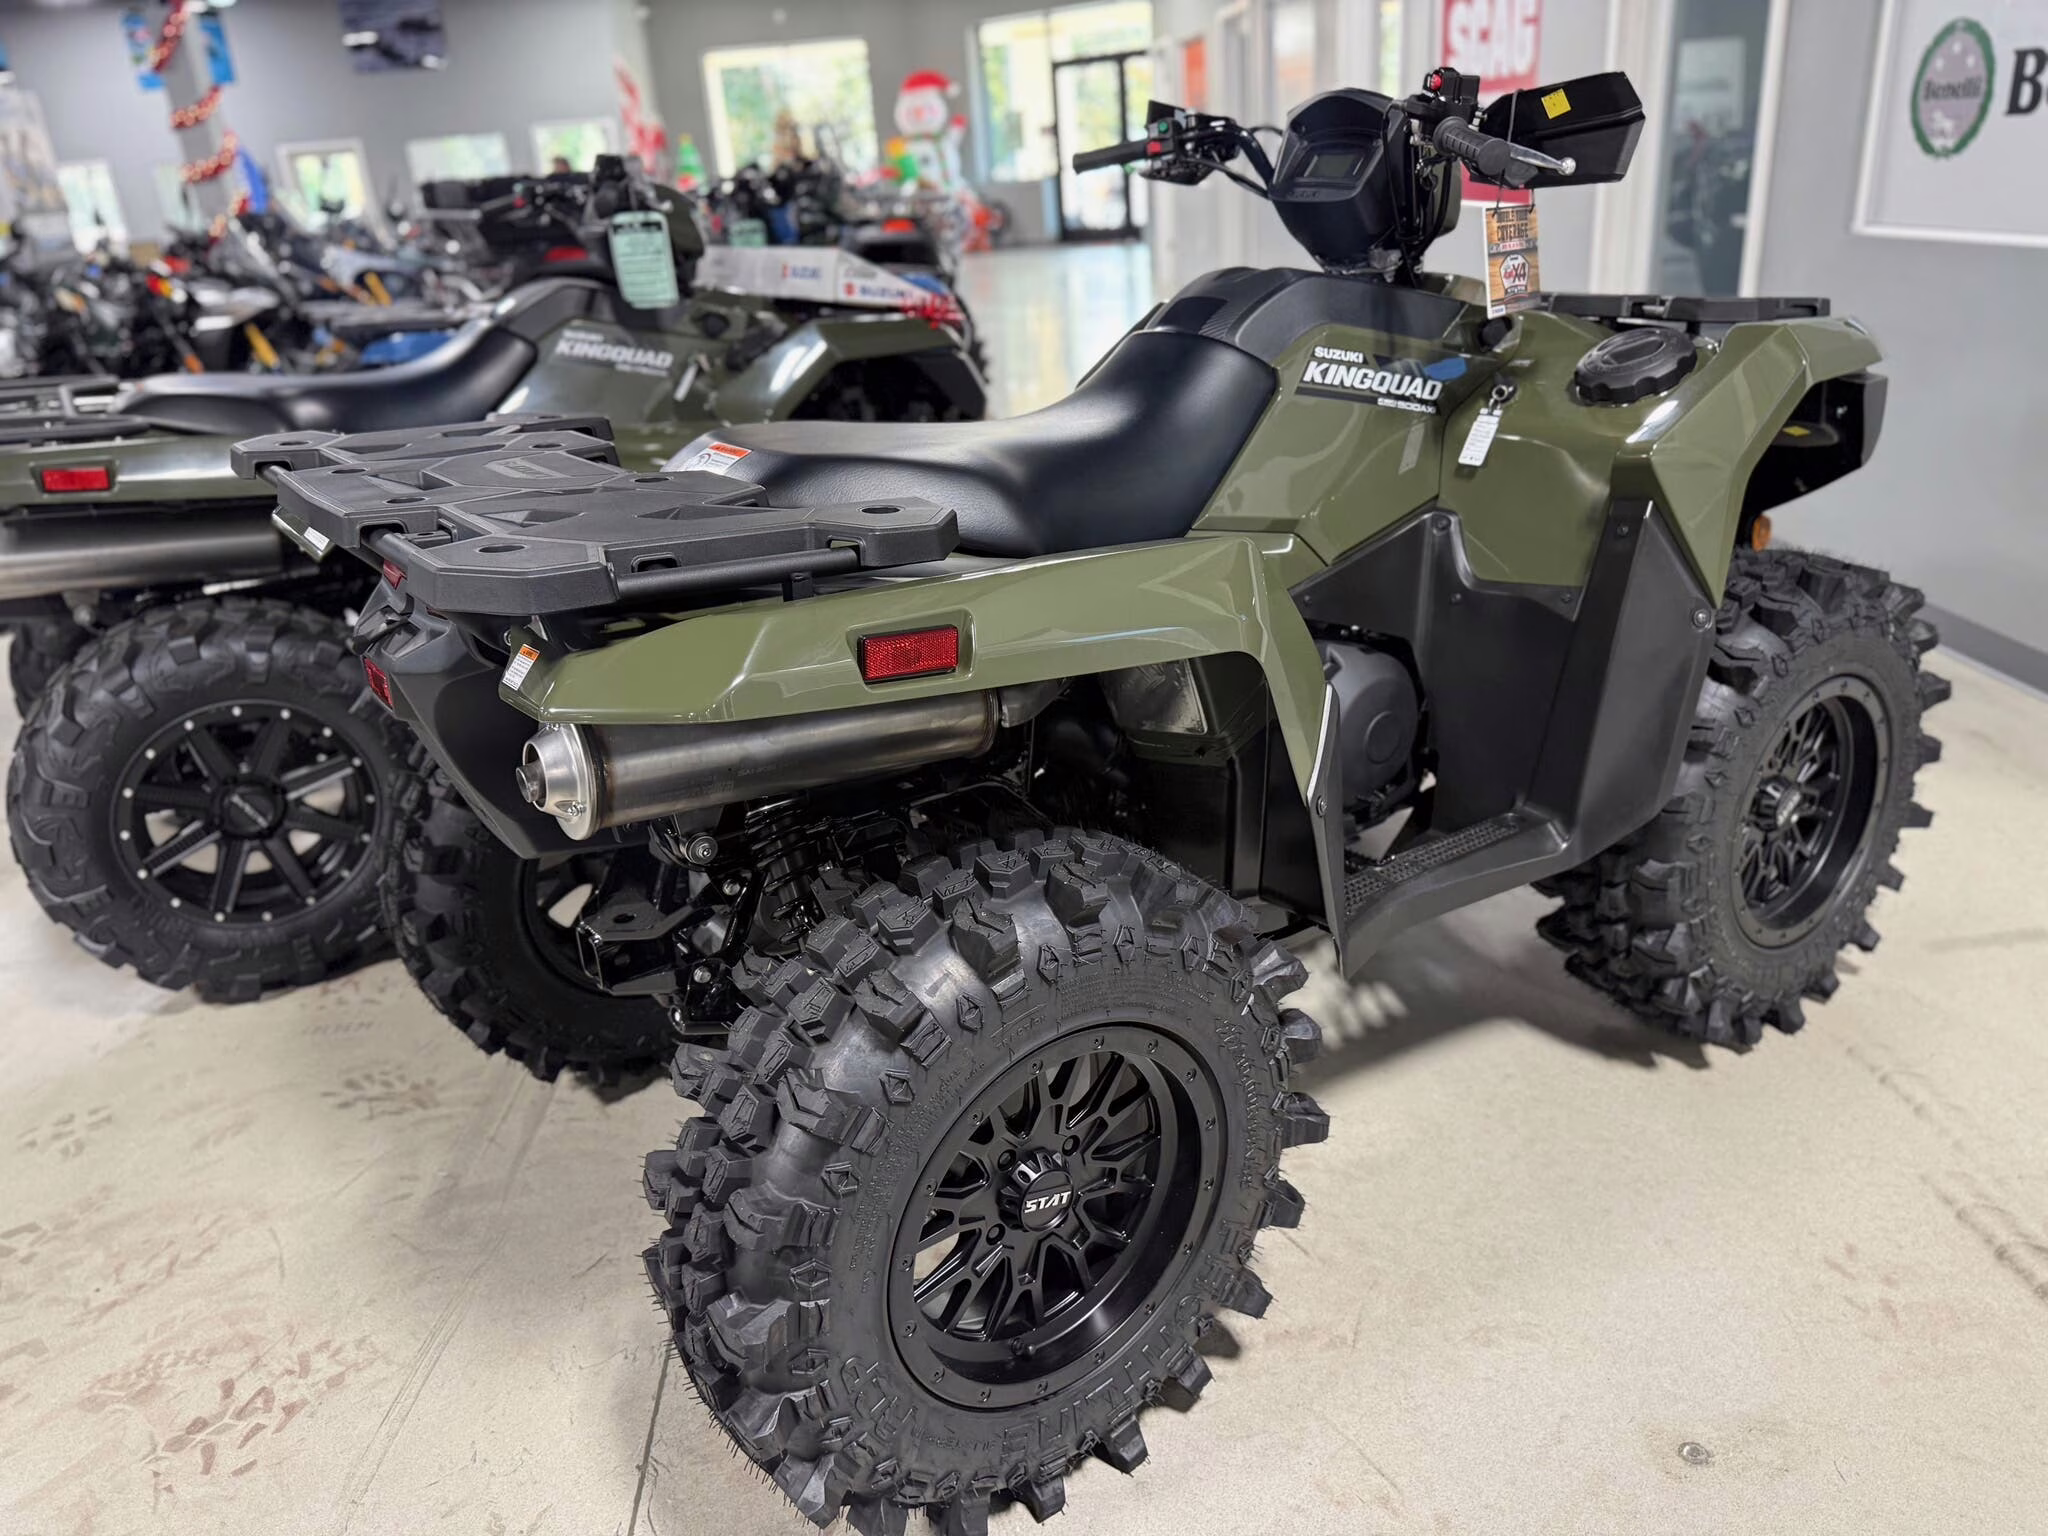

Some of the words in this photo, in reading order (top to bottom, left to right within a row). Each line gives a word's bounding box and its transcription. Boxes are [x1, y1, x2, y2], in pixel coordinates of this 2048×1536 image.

[2005, 47, 2048, 117] B
[1496, 222, 1529, 242] COVERAGE
[554, 338, 675, 370] KINGQUAD
[1313, 346, 1365, 364] SUZUKI
[1302, 361, 1444, 401] KINGQUAD
[1024, 1191, 1072, 1214] STAT
